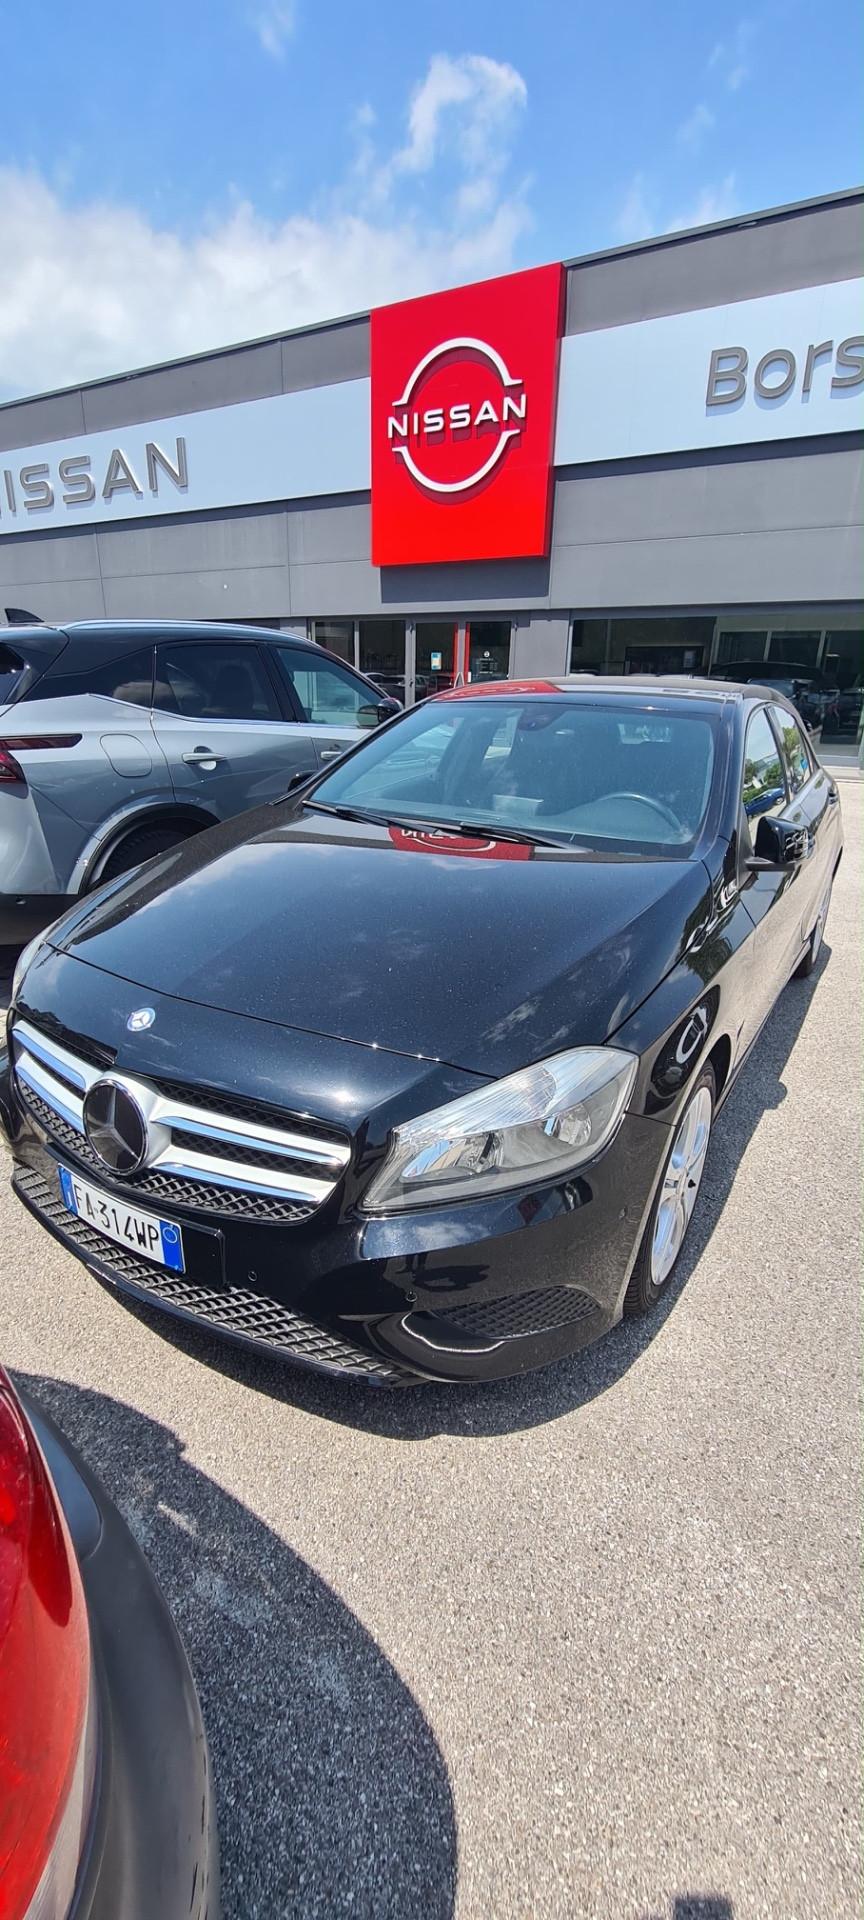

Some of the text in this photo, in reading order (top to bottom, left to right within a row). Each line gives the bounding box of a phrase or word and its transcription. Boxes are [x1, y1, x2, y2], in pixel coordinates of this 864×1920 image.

[705, 335, 864, 406] Bors
[387, 394, 526, 439] NISSAN
[0, 437, 189, 519] ISSAN
